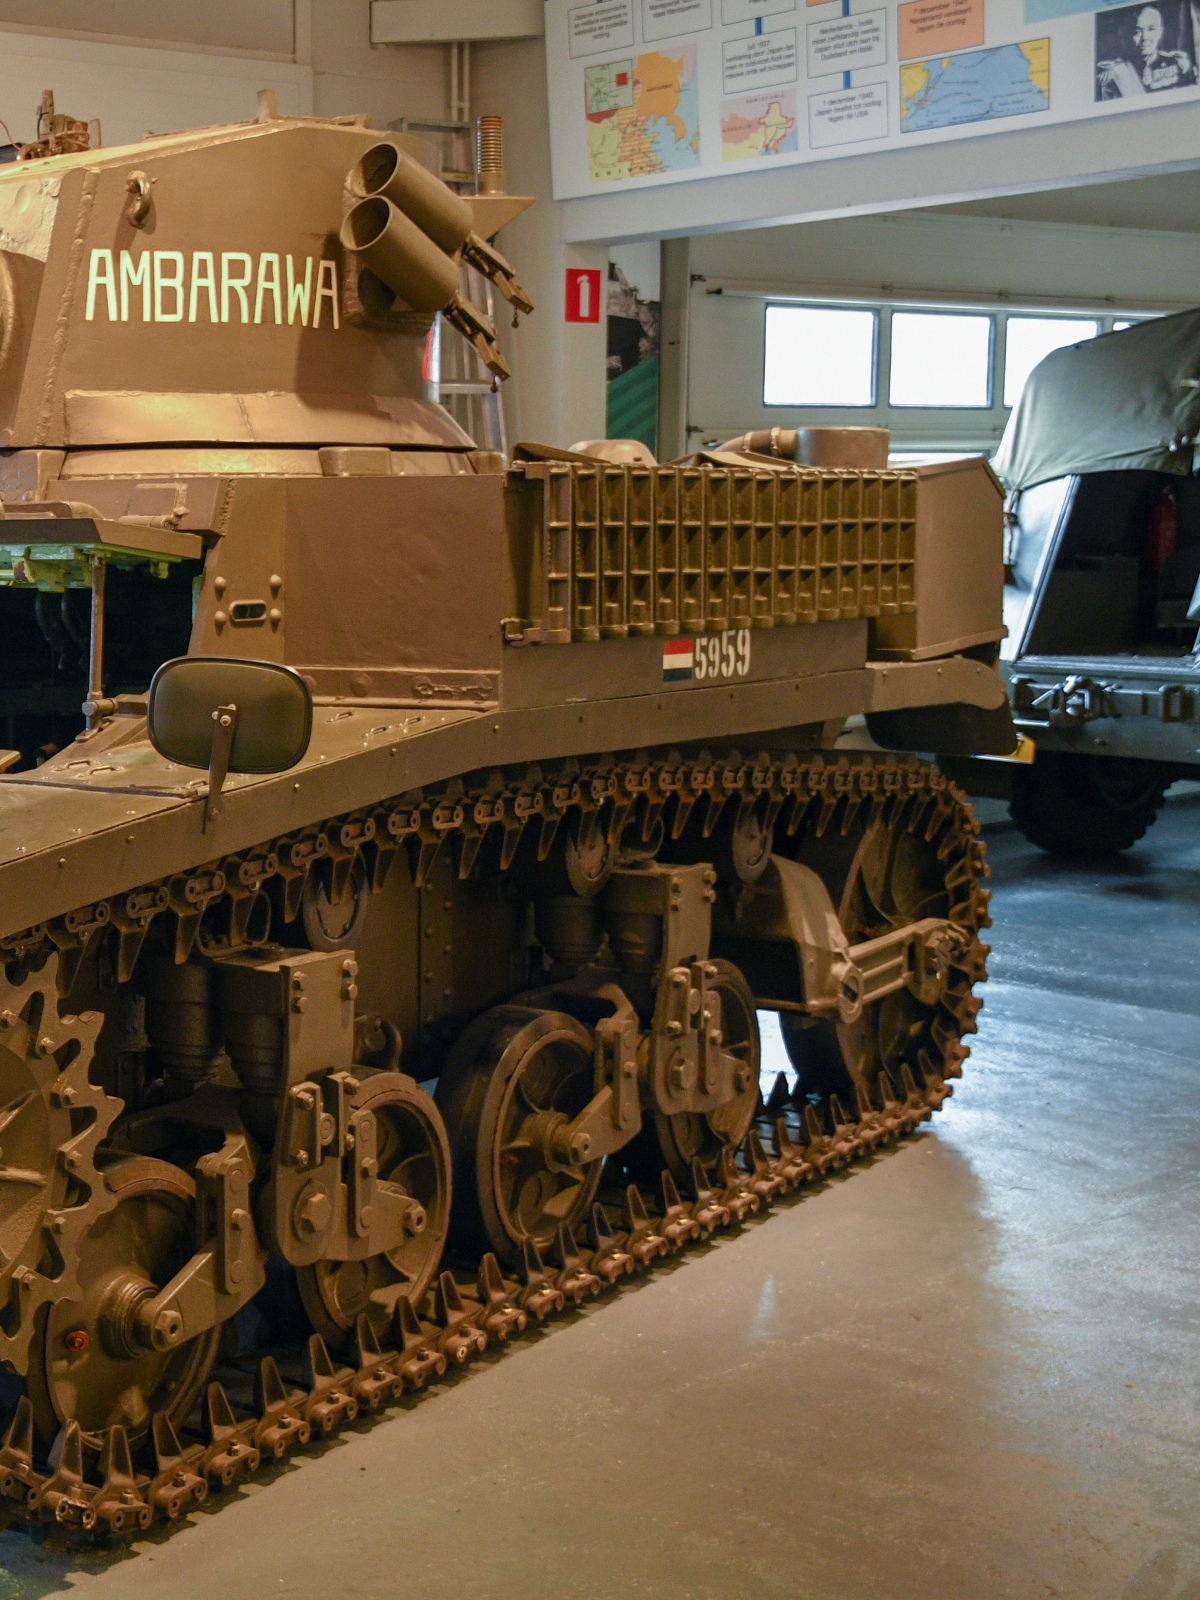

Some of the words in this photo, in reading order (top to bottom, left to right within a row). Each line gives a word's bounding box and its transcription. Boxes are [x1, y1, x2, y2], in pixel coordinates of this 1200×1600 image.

[910, 13, 942, 24] Nederland
[915, 24, 934, 33] Japan
[945, 18, 966, 26] oorlog
[828, 96, 856, 106] december
[85, 248, 339, 329] AMBARAWA
[694, 628, 751, 680] 5959
